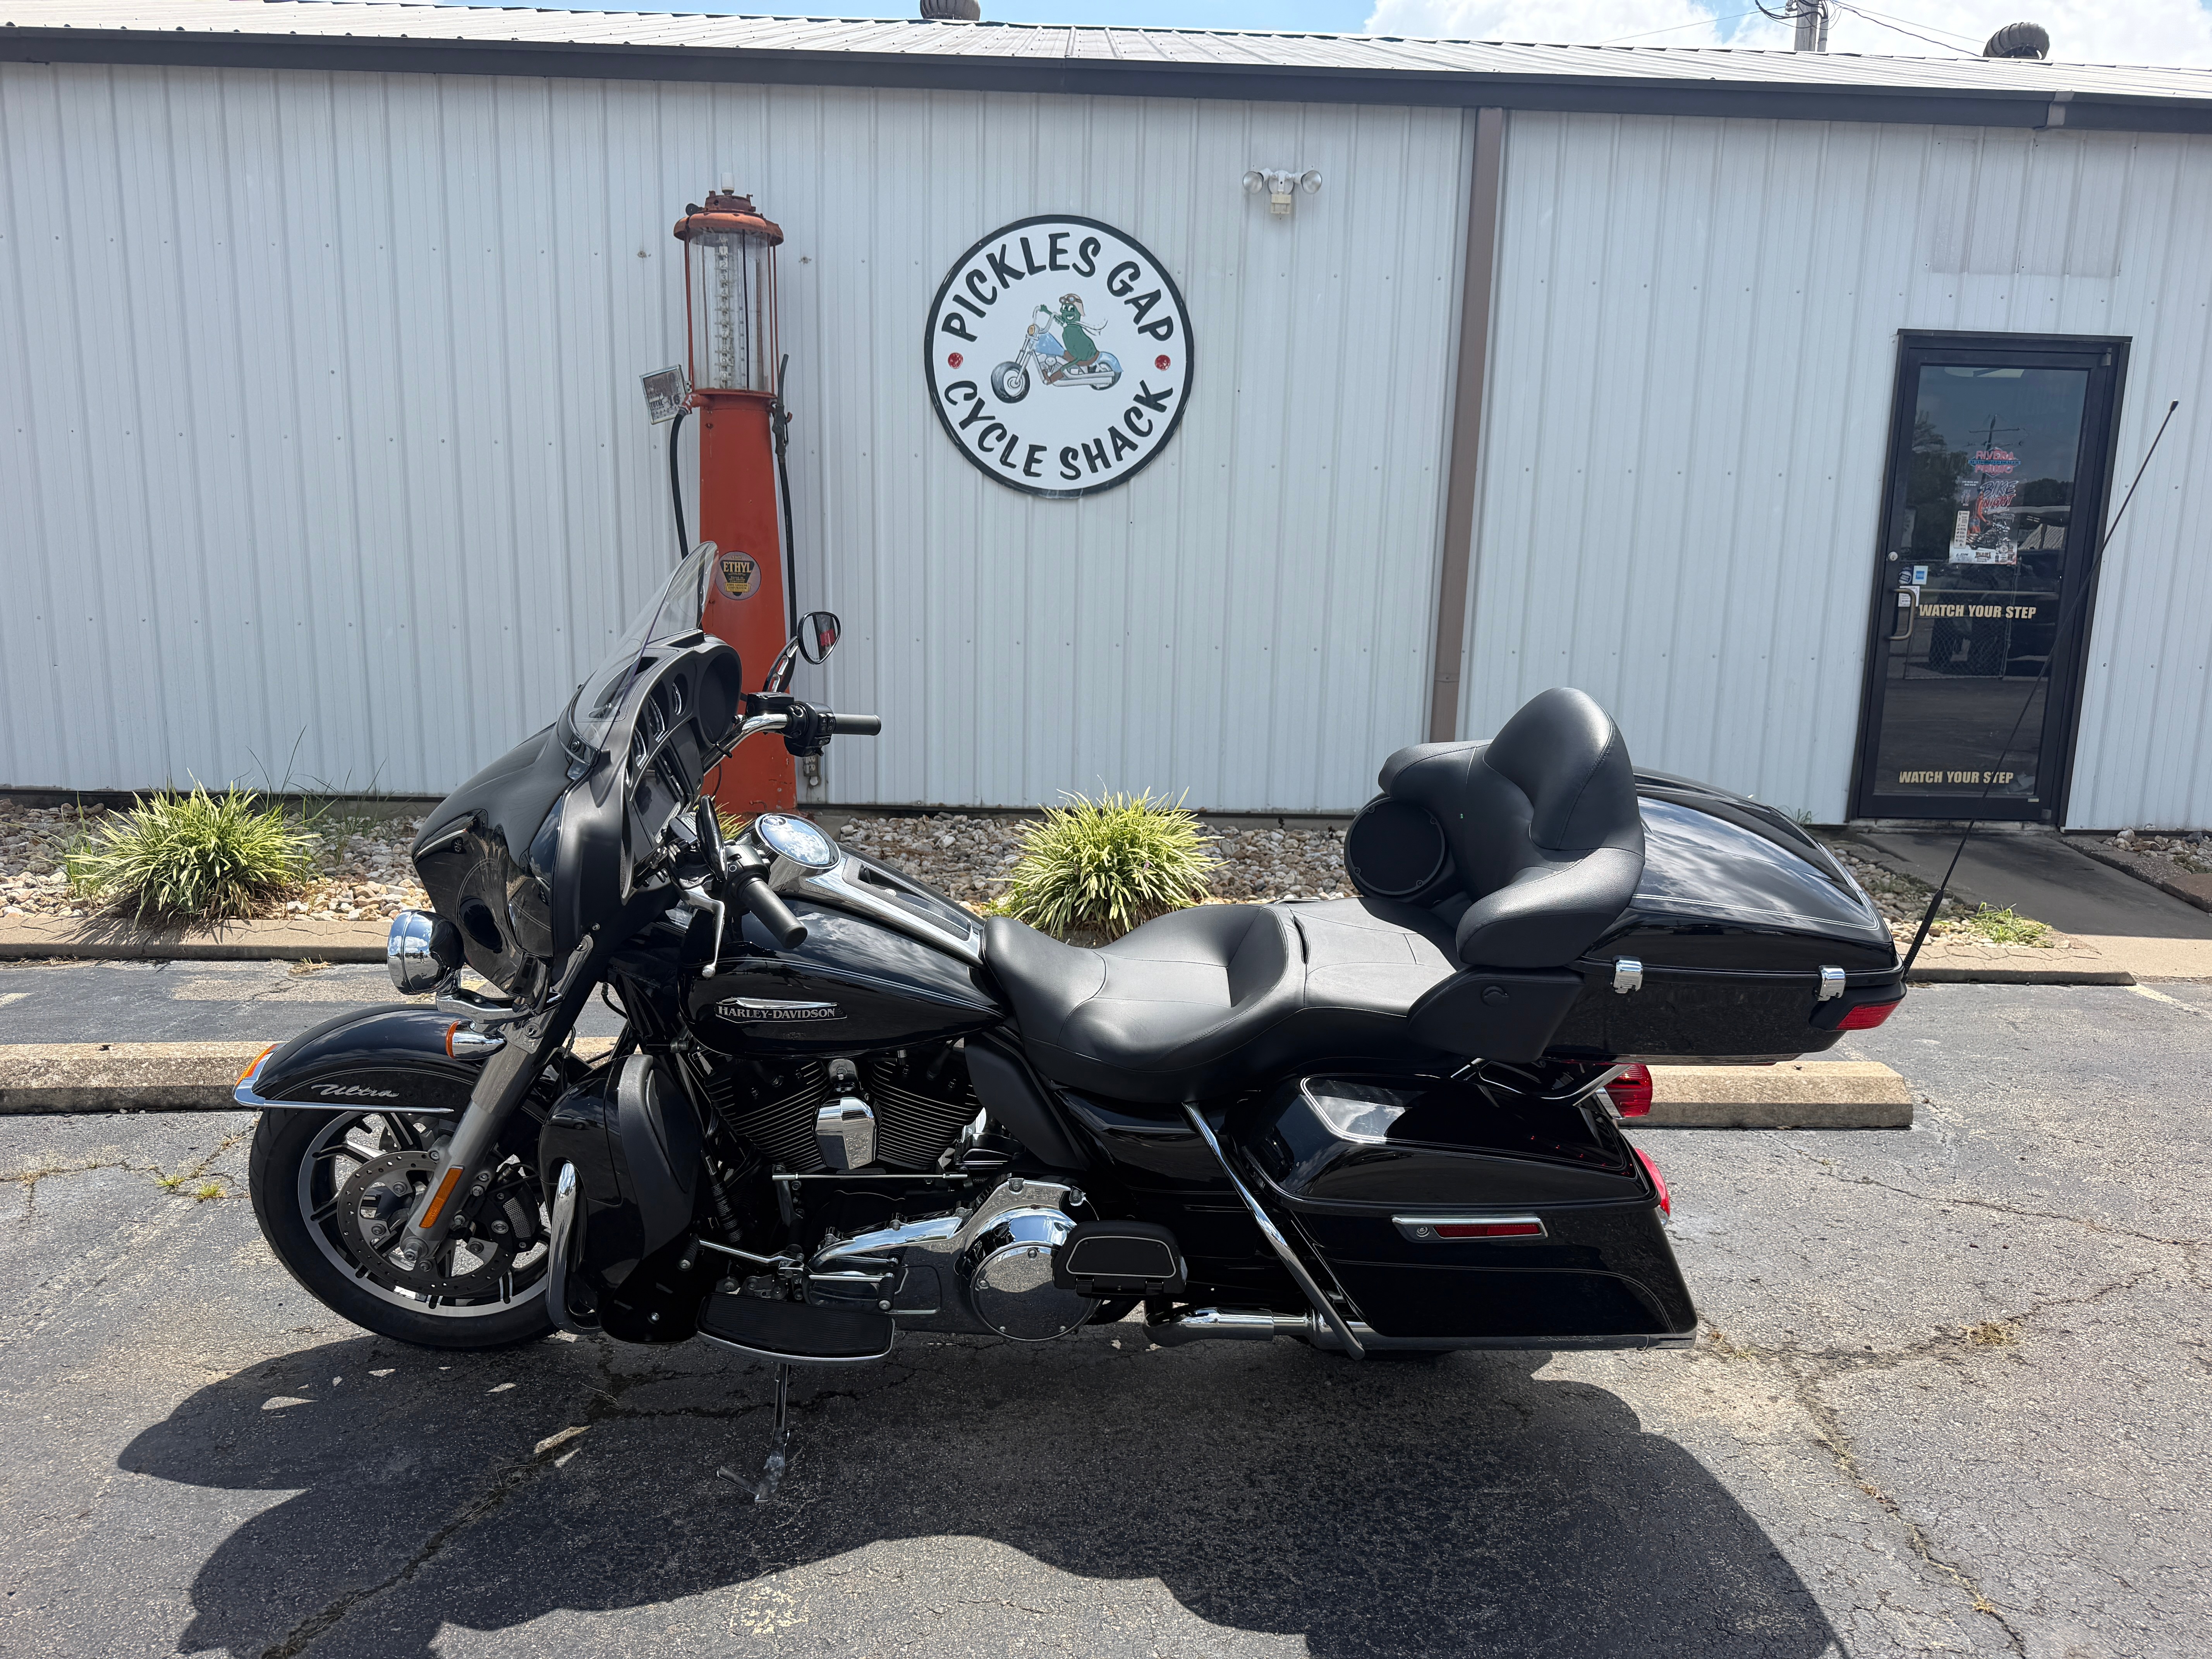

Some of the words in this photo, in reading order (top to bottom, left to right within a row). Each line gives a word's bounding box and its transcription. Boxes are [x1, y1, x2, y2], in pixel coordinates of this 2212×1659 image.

[941, 232, 1101, 342] PICKLES
[1107, 261, 1174, 342] GAP
[944, 380, 1048, 477] CYCLE
[1060, 380, 1173, 480] SHACK
[1975, 450, 2014, 460] RIVERA
[1980, 480, 2019, 497] BIKE
[1983, 493, 2016, 508] NIGHT
[723, 561, 752, 573] ETHYL
[1919, 605, 1964, 617] WATCH
[1968, 605, 2002, 618] YOUR
[2006, 606, 2036, 619] STEP
[1899, 771, 1943, 783] WATCH
[1947, 771, 1980, 783] YOUR
[718, 1006, 835, 1019] HARLEY-DAVIDSON
[311, 1084, 399, 1097] Ultra
